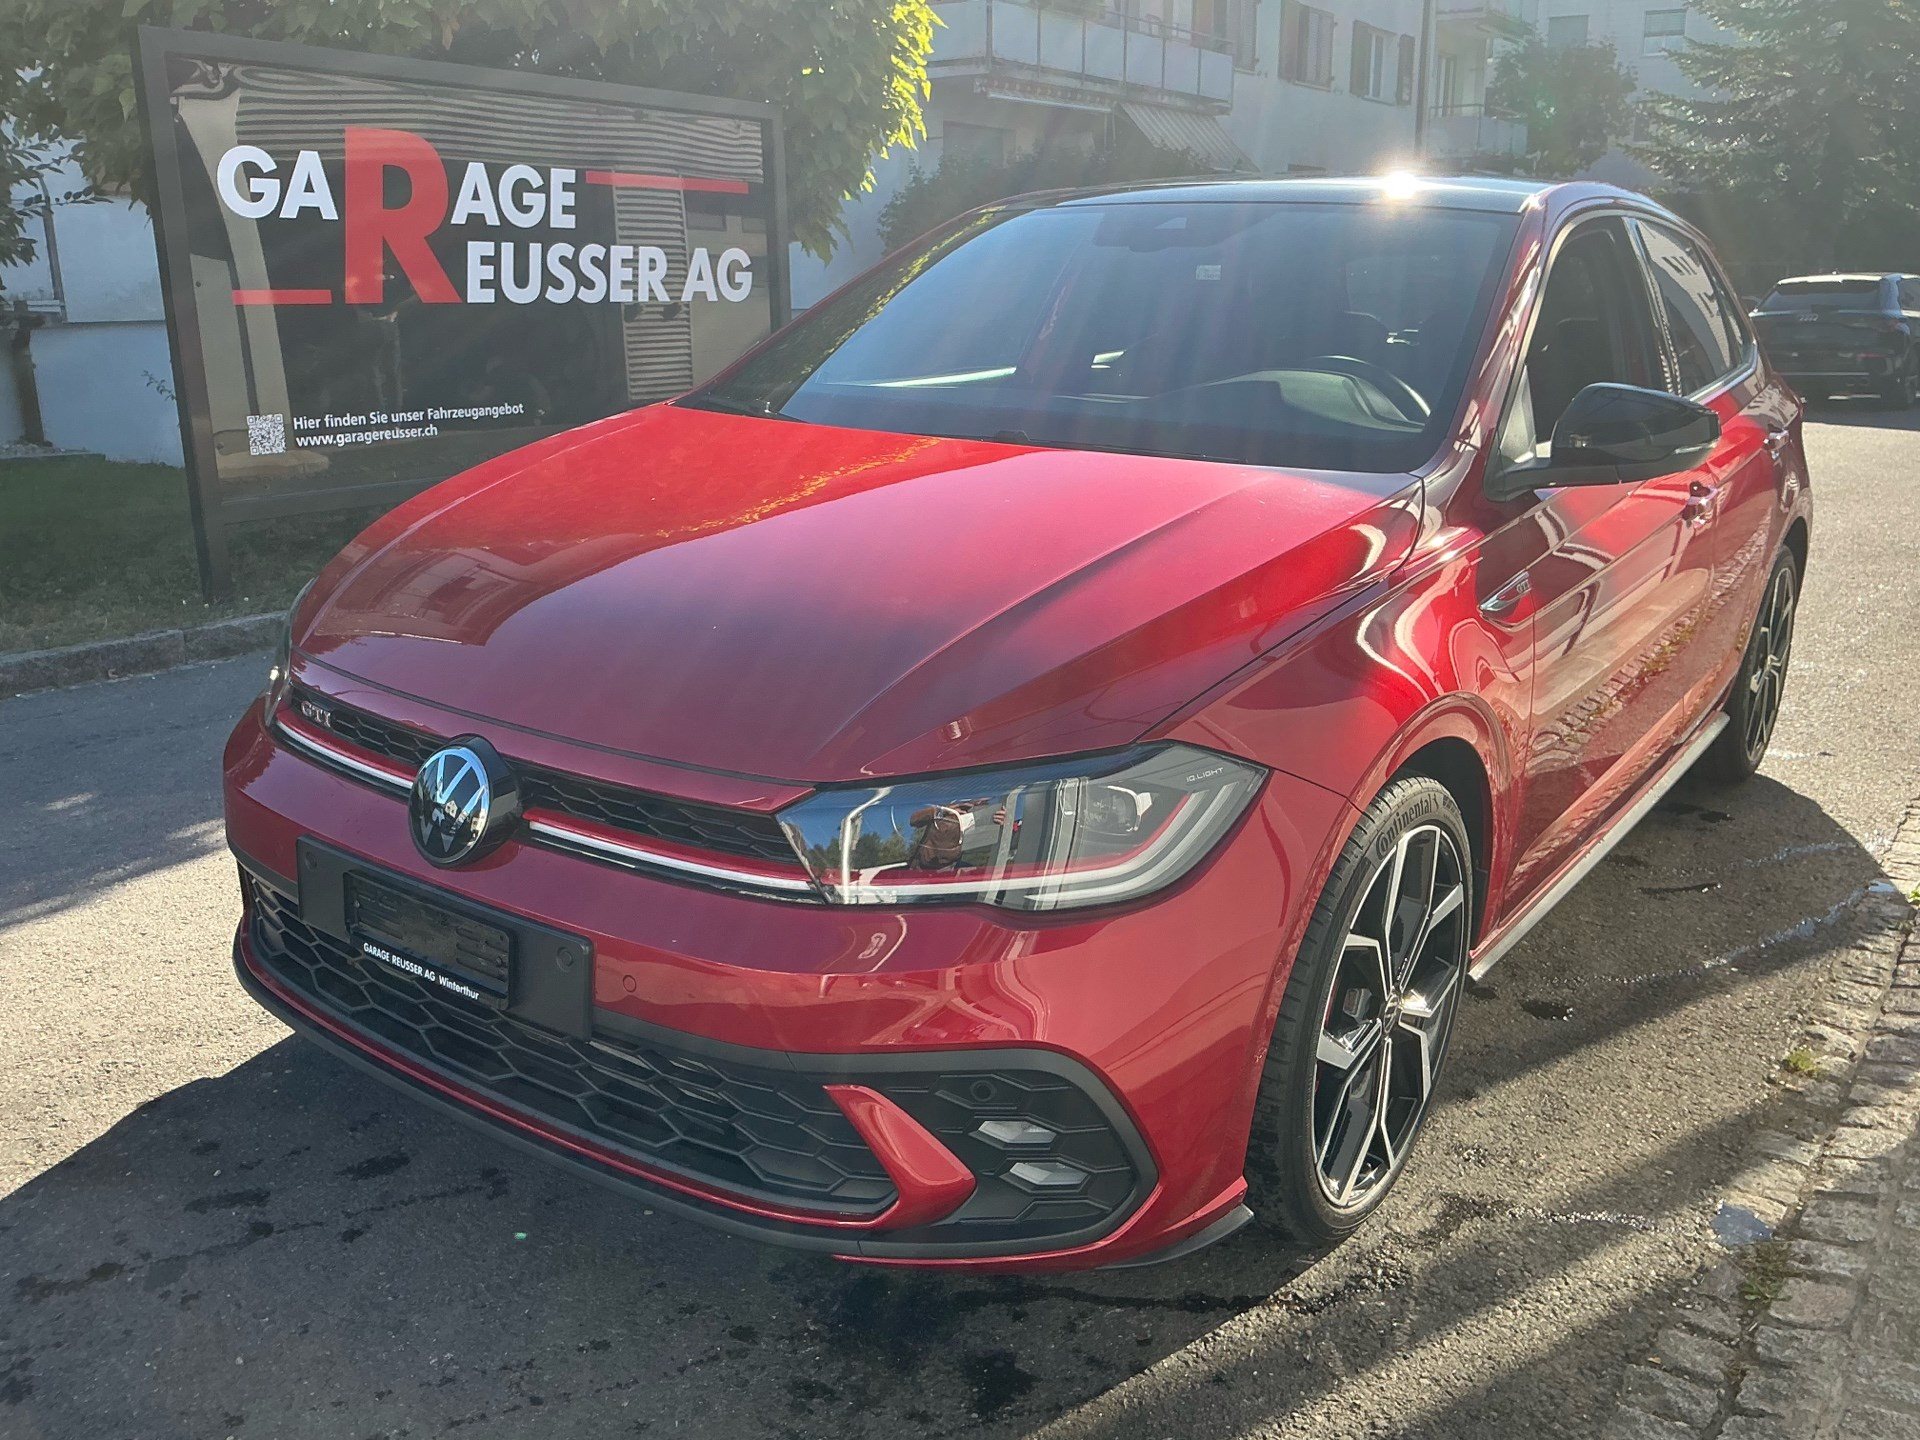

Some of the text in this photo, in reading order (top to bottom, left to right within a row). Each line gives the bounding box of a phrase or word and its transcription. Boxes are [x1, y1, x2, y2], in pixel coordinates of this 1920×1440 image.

[217, 127, 576, 304] GARAGE
[680, 247, 753, 303] AG
[293, 403, 525, 430] Hier finden Sie unser Fahrzeugangebot
[296, 424, 438, 447] www.garagereusser.ch
[1186, 767, 1224, 783] IQ.LIGHT
[1375, 794, 1433, 860] Continental
[363, 942, 480, 1000] GARAGE REUSSER AG Winterthur
